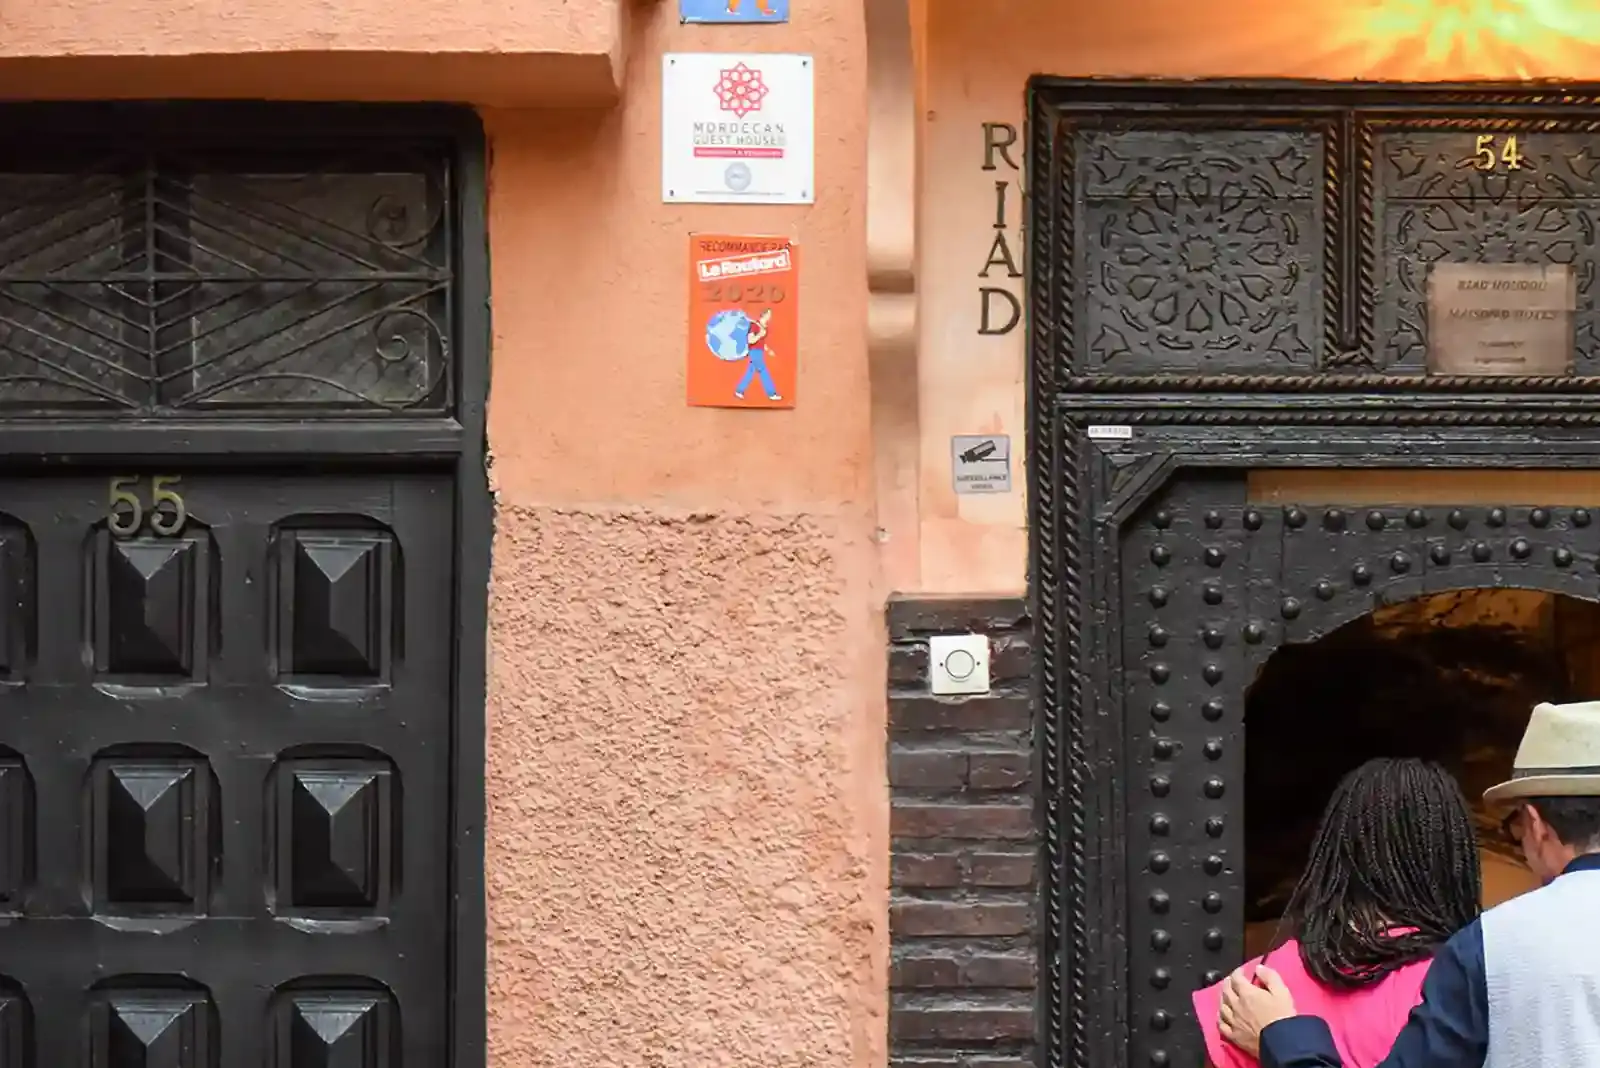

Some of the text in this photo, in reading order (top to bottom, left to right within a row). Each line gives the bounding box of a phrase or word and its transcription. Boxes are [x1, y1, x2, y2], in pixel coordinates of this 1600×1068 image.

[693, 121, 784, 134] MOROCCAN
[693, 134, 732, 145] GUEST
[1473, 134, 1525, 172] 54
[977, 121, 1023, 336] RIAD
[701, 262, 721, 277] Le
[702, 283, 786, 304] 2020
[107, 475, 186, 536] 55
